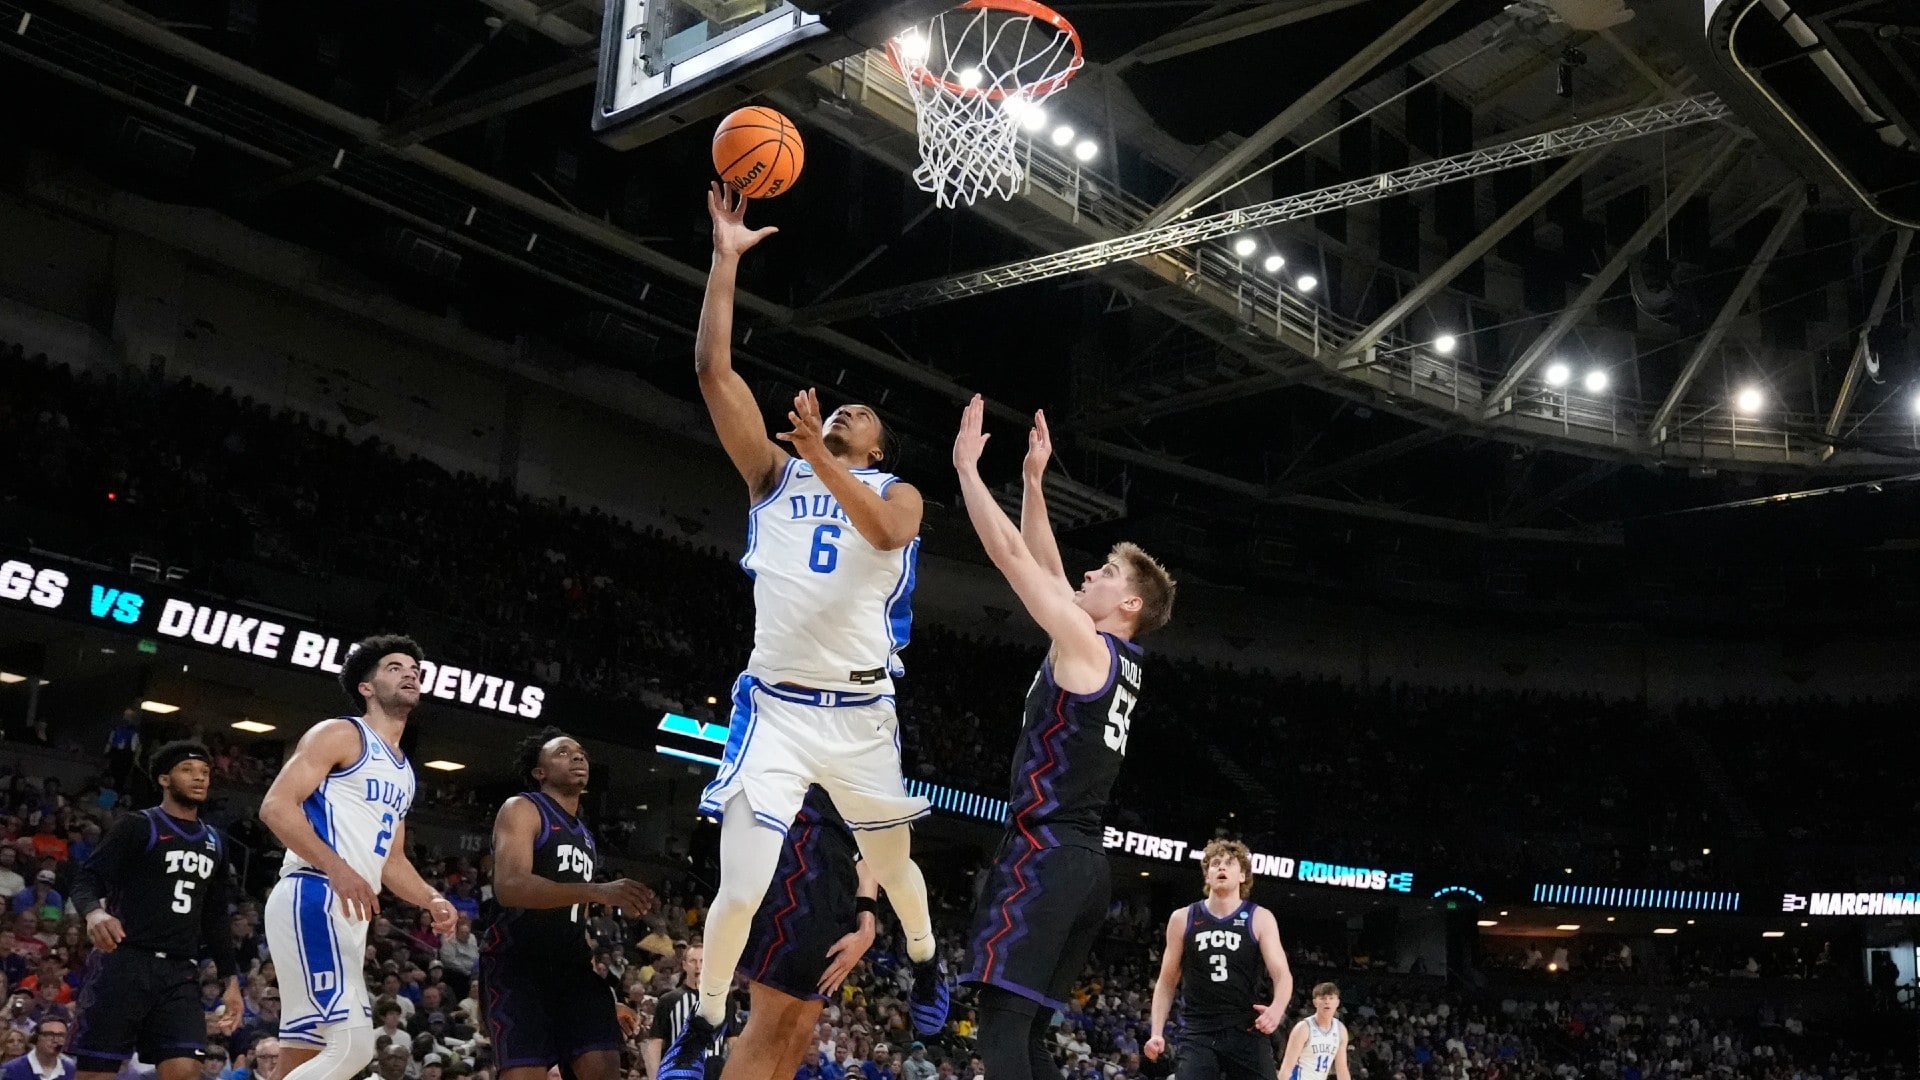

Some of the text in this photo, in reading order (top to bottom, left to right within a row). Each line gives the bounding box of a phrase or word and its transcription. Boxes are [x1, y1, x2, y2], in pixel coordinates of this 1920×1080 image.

[790, 494, 849, 523] DUK
[808, 524, 842, 574] 6
[0, 560, 69, 608] GS
[90, 584, 144, 624] VS
[157, 598, 286, 658] DUKE
[291, 631, 362, 673] BL
[818, 691, 836, 707] D
[374, 812, 394, 857] 2
[165, 850, 215, 879] TCU
[557, 844, 594, 882] TCU
[1125, 831, 1188, 861] FIRST
[1298, 860, 1387, 890] ROUNDS
[171, 880, 196, 914] 5
[1809, 892, 1920, 915] MARCHMA
[1195, 930, 1241, 951] TCU
[313, 970, 335, 992] D
[1209, 954, 1228, 982] 3
[1312, 1043, 1336, 1054] DUKE
[1315, 1055, 1329, 1073] 14
